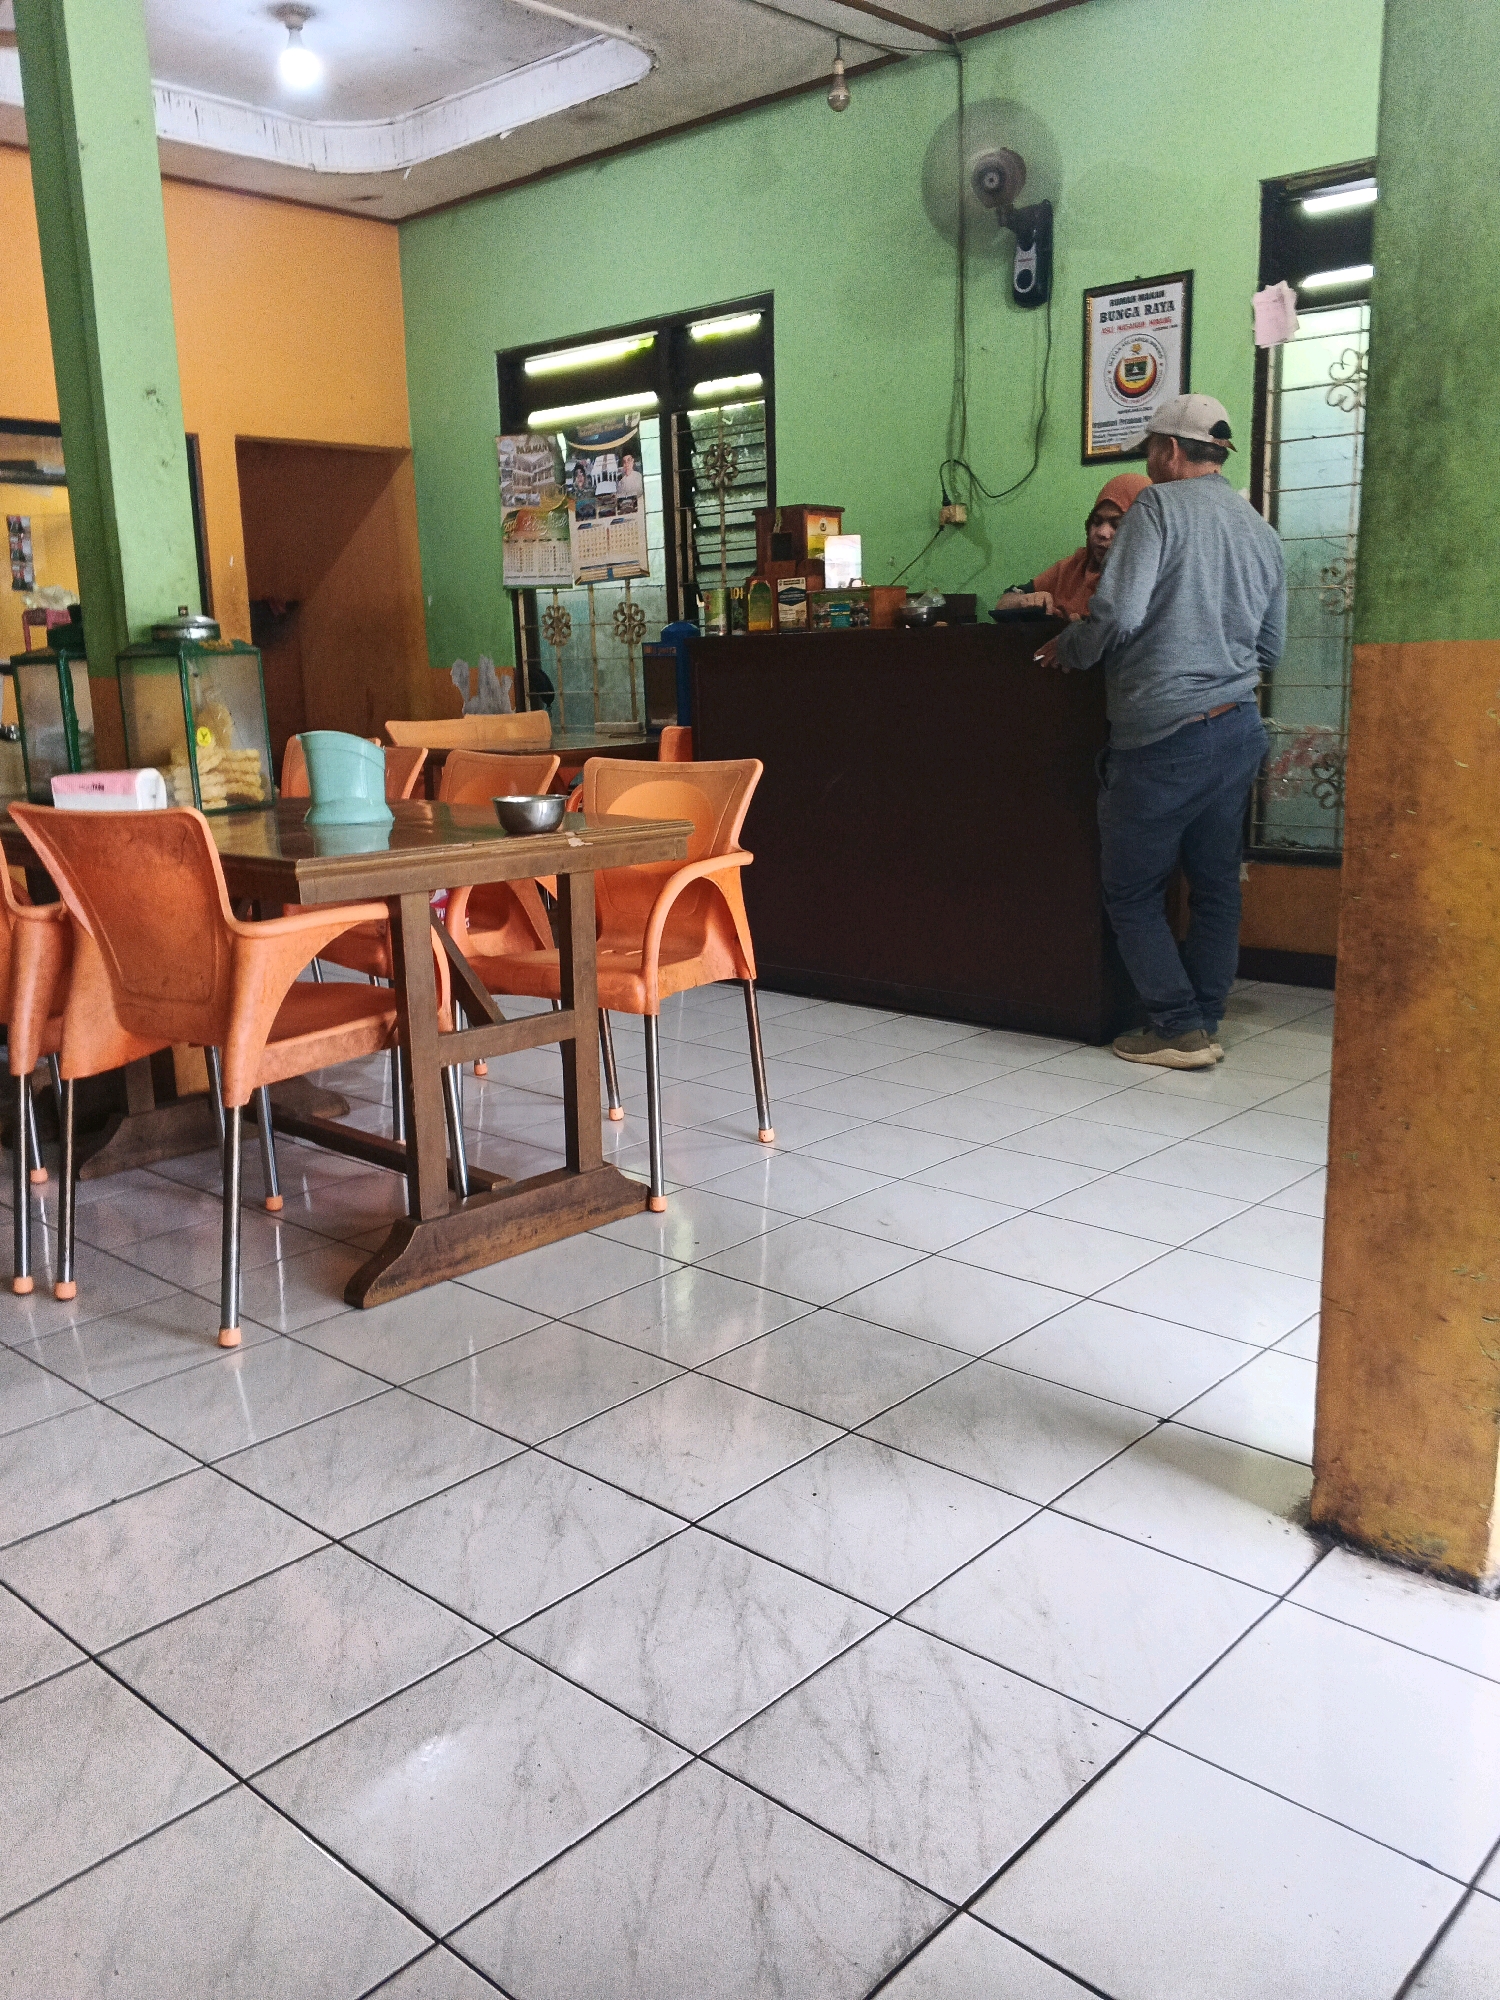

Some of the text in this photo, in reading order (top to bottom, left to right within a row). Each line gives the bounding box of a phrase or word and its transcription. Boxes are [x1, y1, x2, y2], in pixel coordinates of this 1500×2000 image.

[1138, 289, 1165, 302] MAKAN
[1099, 300, 1175, 324] BUNGA RAYA
